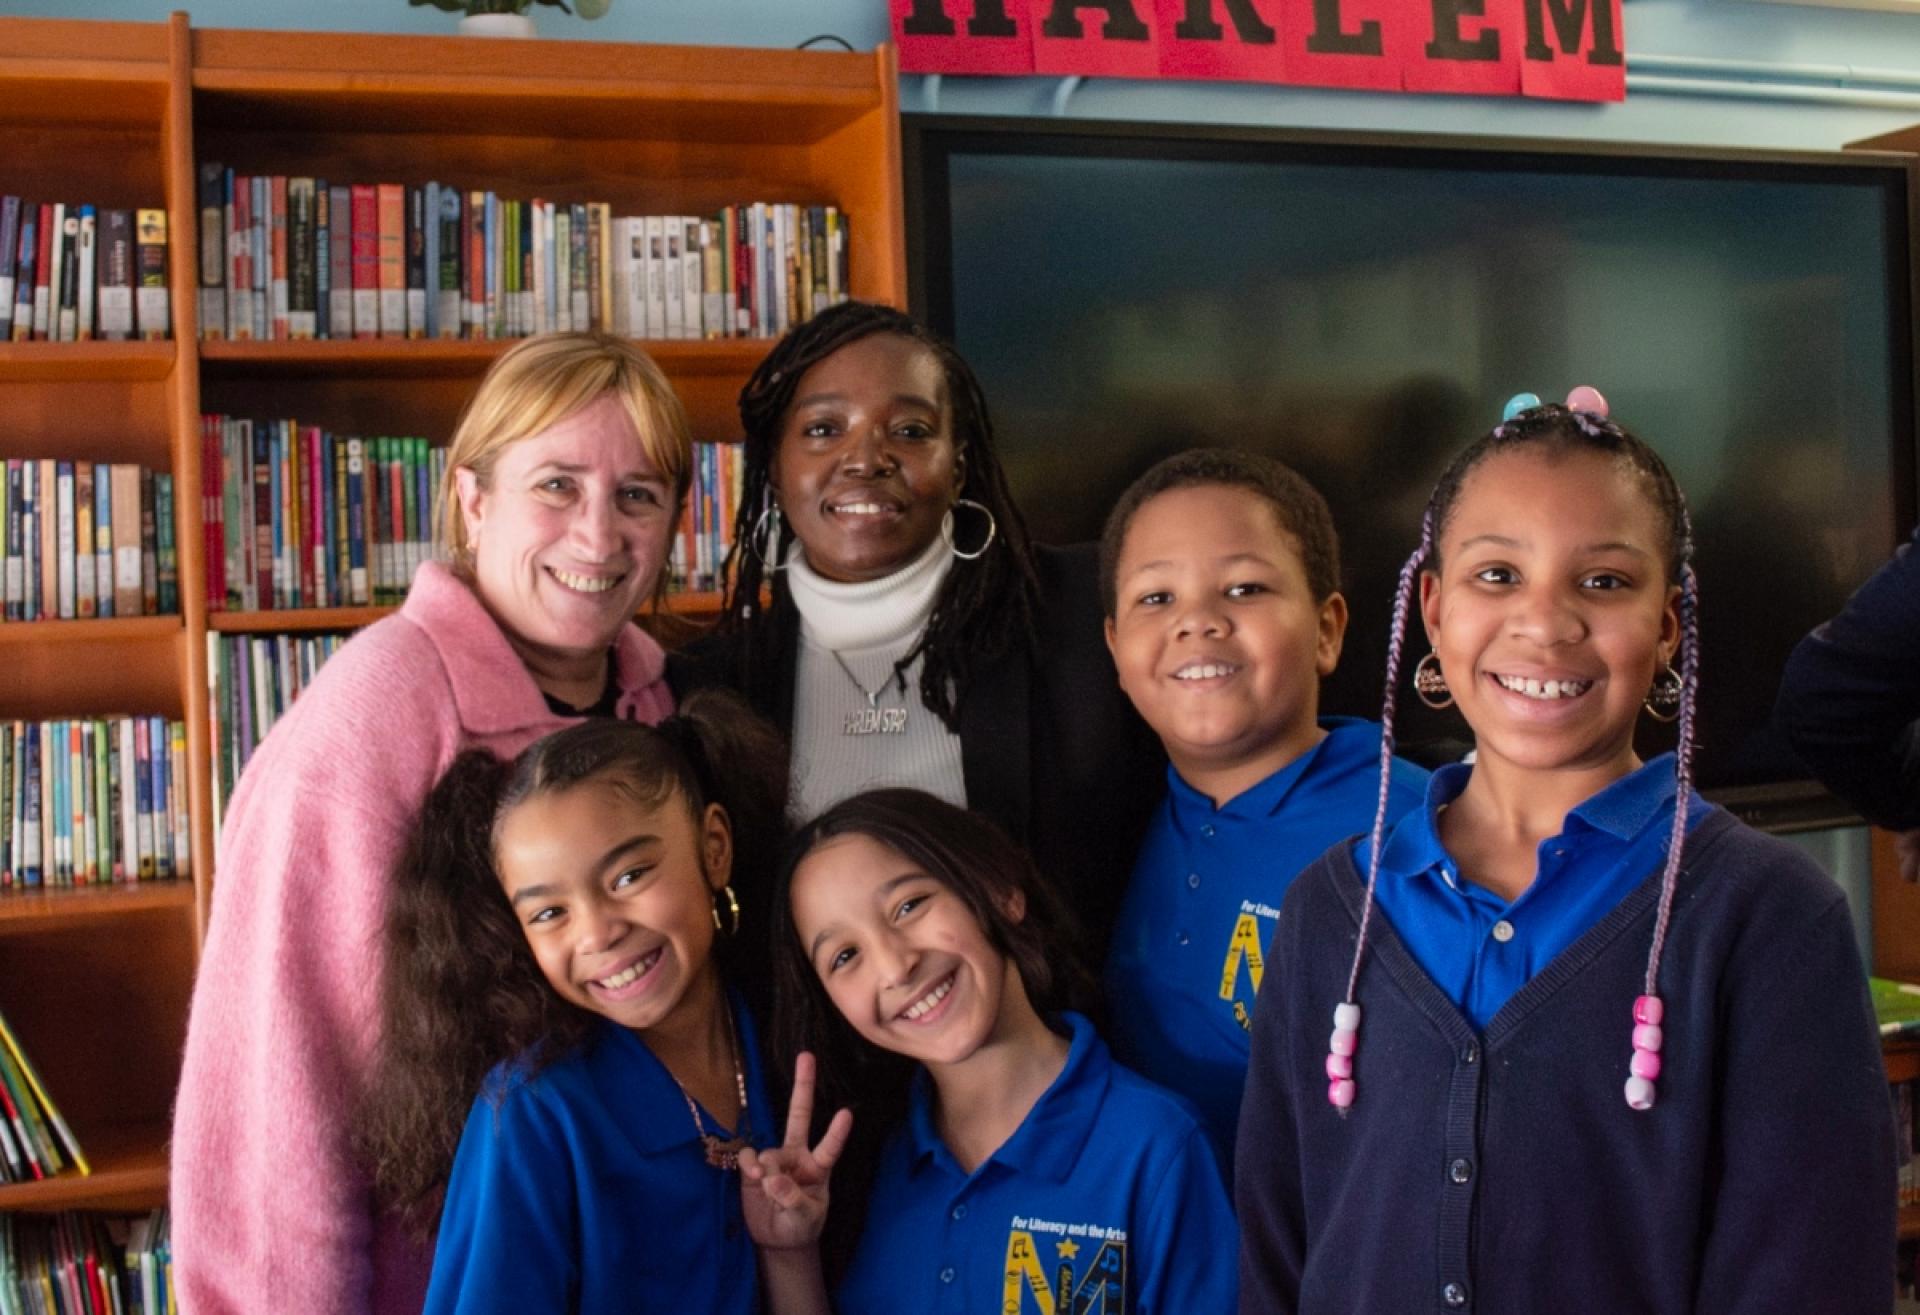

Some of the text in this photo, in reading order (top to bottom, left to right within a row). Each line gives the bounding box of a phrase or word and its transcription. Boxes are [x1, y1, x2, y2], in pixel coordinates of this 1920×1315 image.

[1011, 1215, 1028, 1229] For
[1029, 1218, 1067, 1236] Literacy
[1068, 1223, 1087, 1236] and
[1088, 1224, 1104, 1239] the
